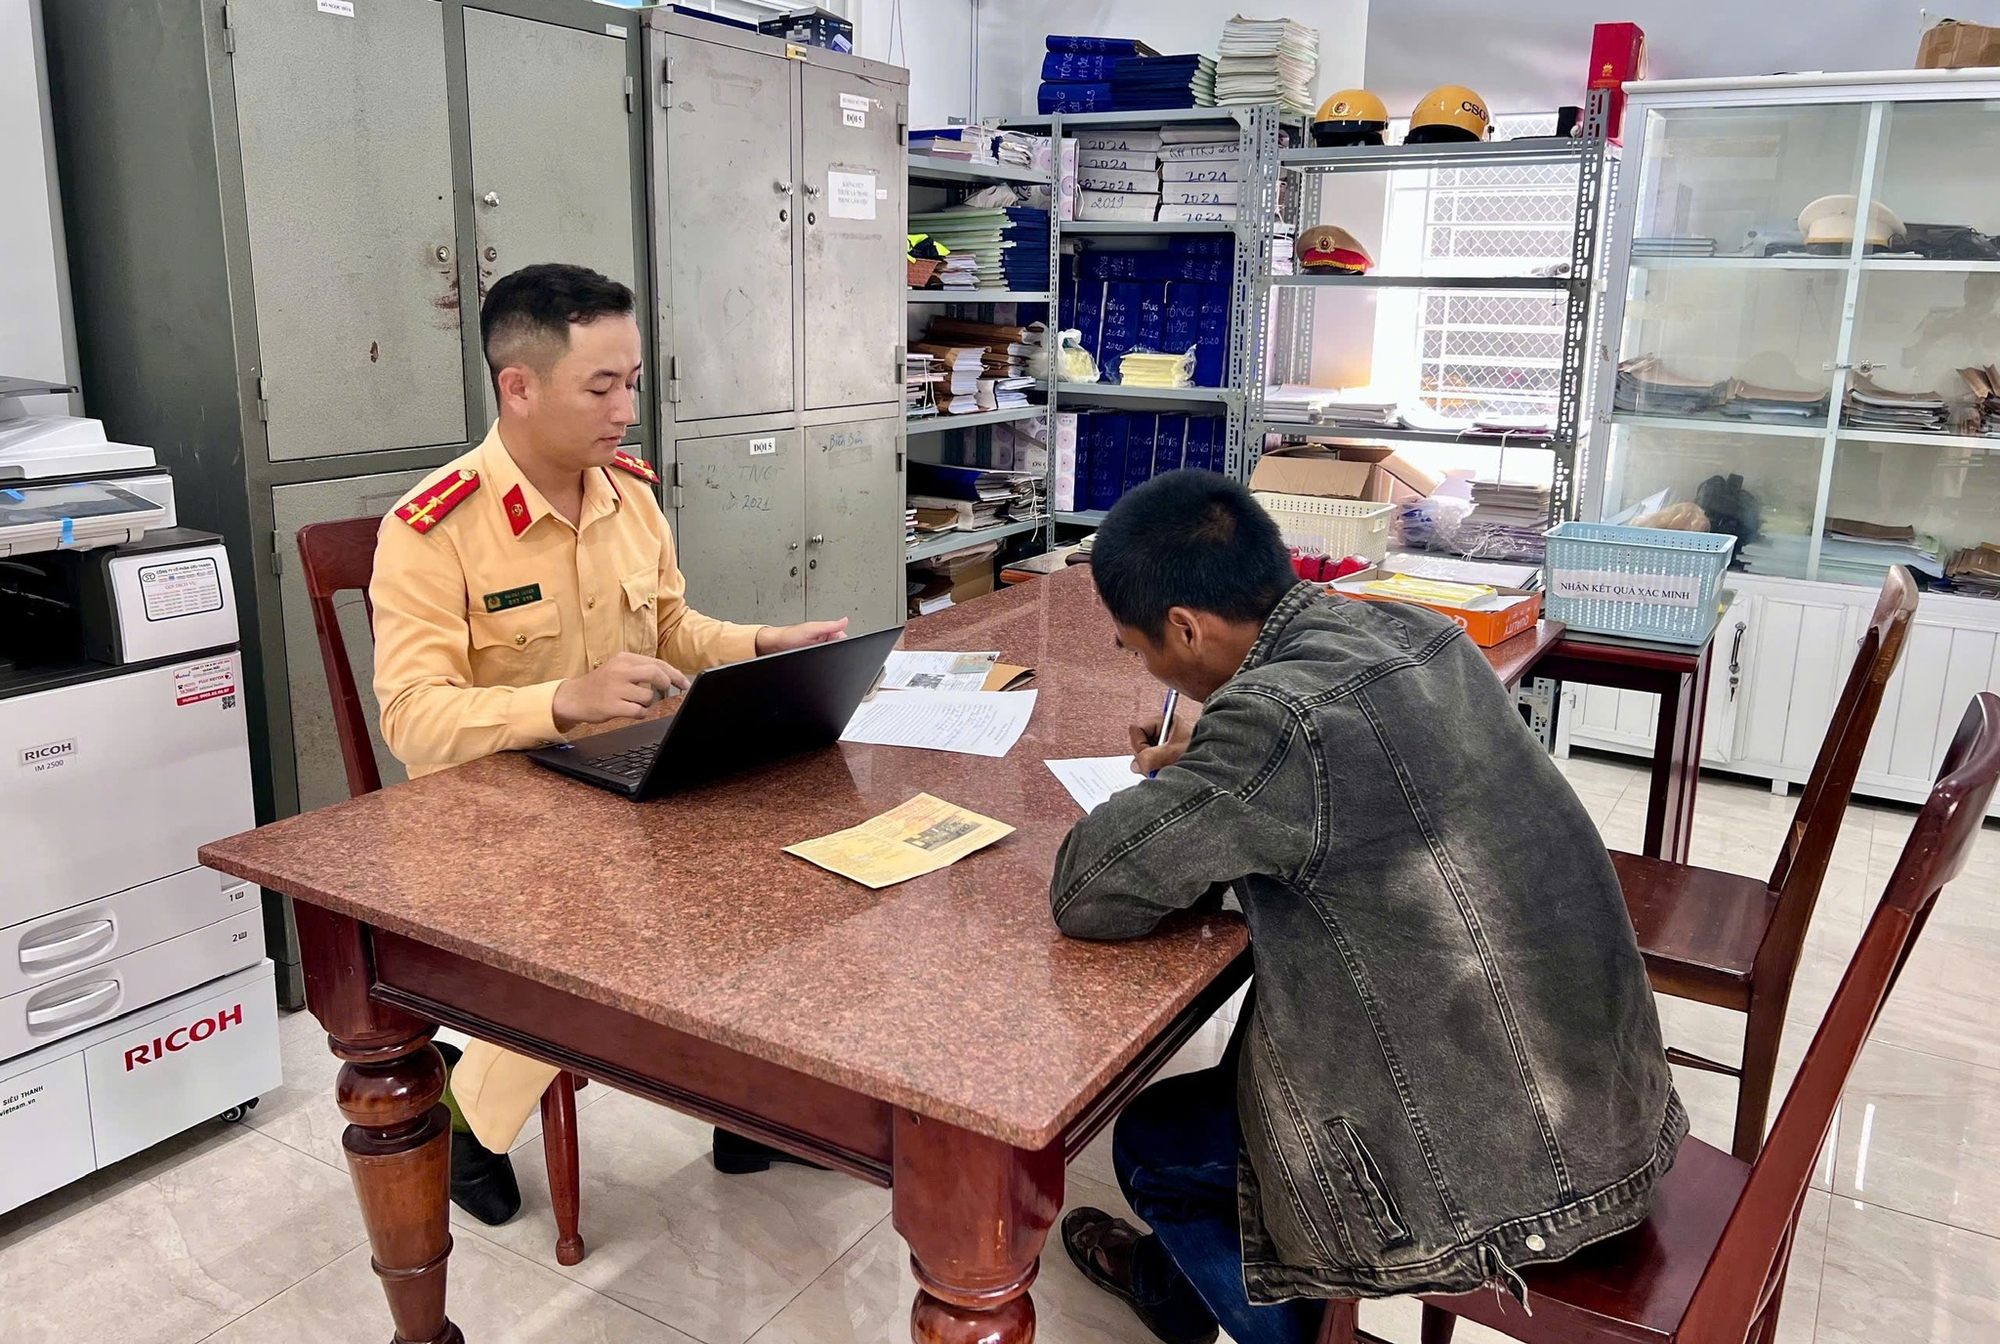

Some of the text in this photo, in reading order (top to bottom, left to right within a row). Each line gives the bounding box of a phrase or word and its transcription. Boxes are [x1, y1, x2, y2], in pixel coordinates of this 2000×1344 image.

[1561, 581, 1690, 600] NHẬN KẾT QUẢ XÁC MINH
[24, 743, 72, 761] RICOH
[34, 760, 64, 772] IM 2500
[229, 894, 234, 902] 1
[232, 933, 238, 943] 2
[124, 1003, 243, 1073] RICOH
[20, 1085, 44, 1098] THANH
